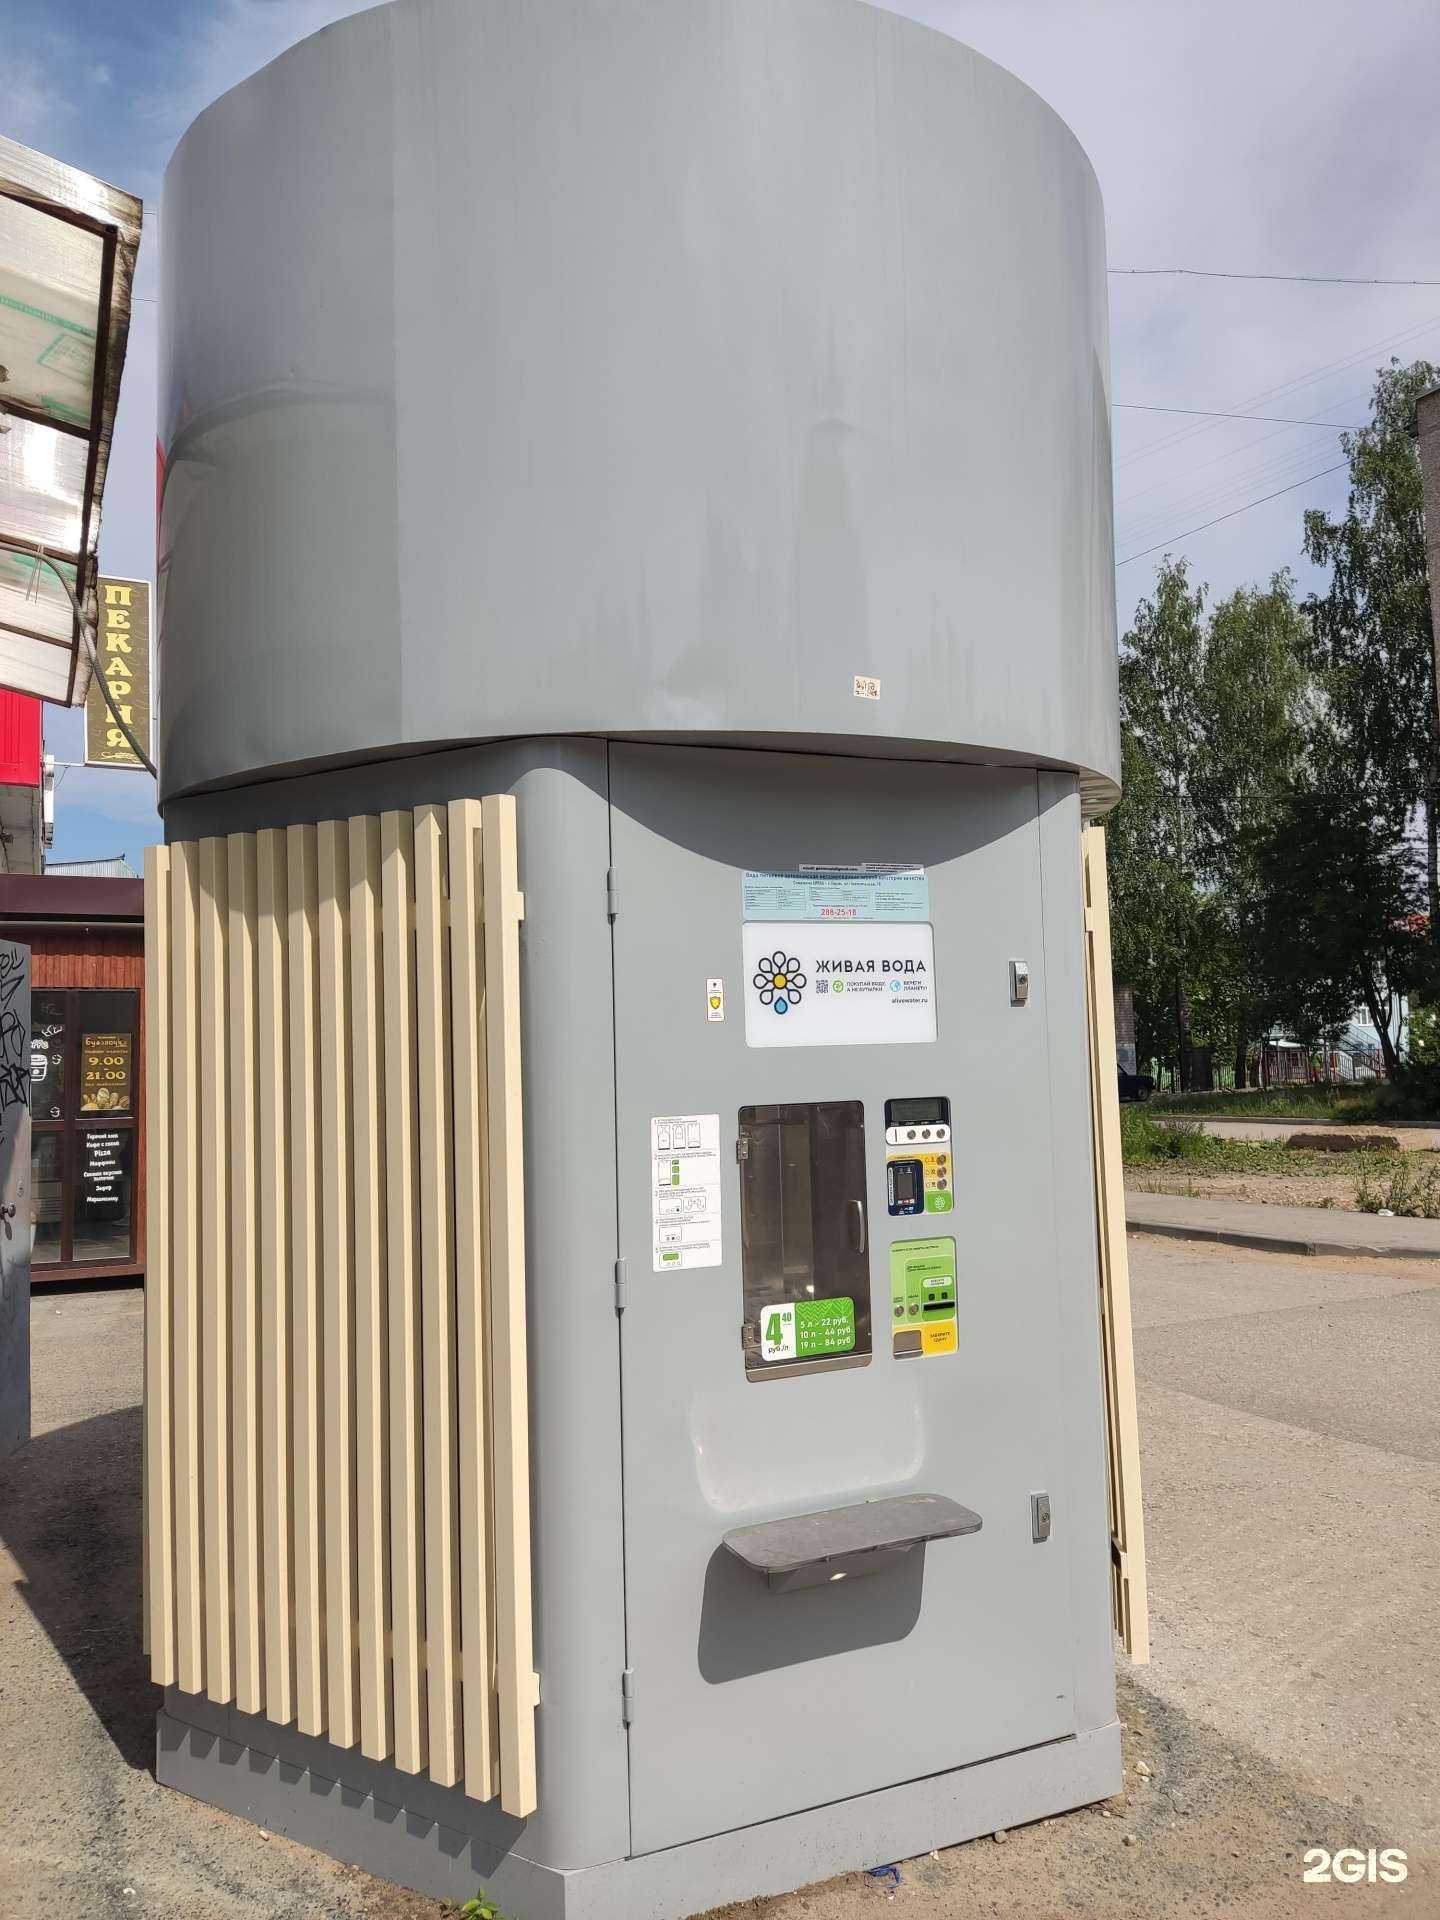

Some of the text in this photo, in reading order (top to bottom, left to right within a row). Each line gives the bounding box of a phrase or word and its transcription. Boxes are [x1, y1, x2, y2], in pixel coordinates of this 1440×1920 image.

[104, 584, 133, 748] ПЕКАРНЯ
[816, 960, 926, 974] ЖИВАЯ ВОДА
[88, 1056, 124, 1066] 9.00
[86, 1071, 126, 1080] 21.00
[781, 1312, 792, 1322] 40
[821, 1318, 831, 1326] 22
[766, 1313, 783, 1345] 4
[800, 1331, 809, 1339] 10
